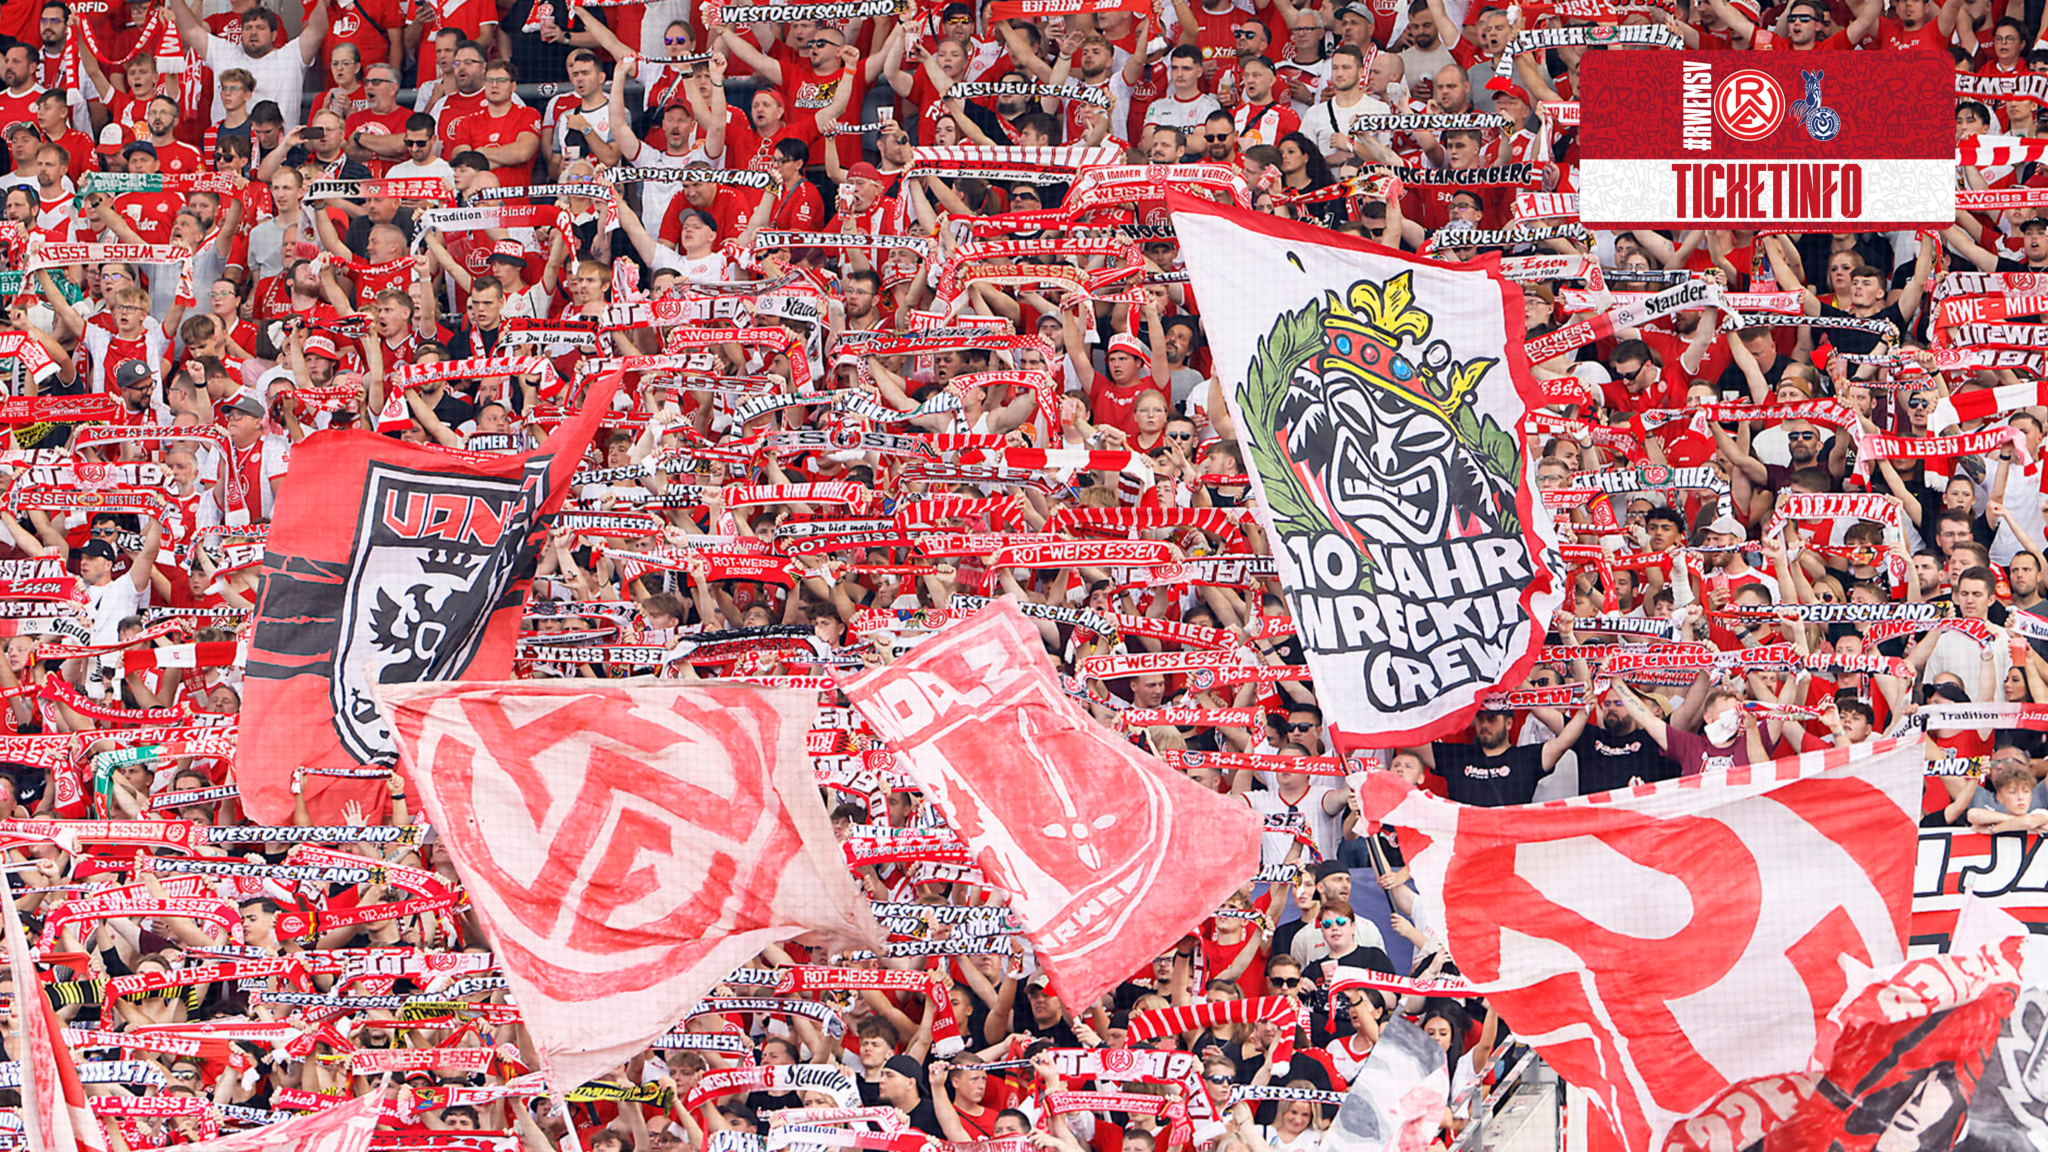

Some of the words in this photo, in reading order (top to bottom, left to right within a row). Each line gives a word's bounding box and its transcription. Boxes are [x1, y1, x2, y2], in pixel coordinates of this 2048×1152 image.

[724, 2, 893, 25] WESTDEUTSCHLAND
[1174, 168, 1202, 180] MEIN
[431, 211, 482, 224] Tradition
[1520, 255, 1569, 270] Essen
[1645, 284, 1707, 315] Stauder
[1947, 305, 1985, 327] RWE
[738, 328, 786, 343] Essen
[1525, 322, 1591, 353] ROT-WEISS
[1528, 332, 1596, 363] ESSEN
[1873, 442, 1901, 457] EIN
[1907, 438, 1960, 457] LEBEN
[20, 493, 78, 505] ESSEN
[1012, 545, 1103, 566] ROT-WEISS
[1104, 542, 1161, 560] ESSEN
[713, 556, 779, 570] ROT-WEISS
[726, 567, 764, 577] ESSEN
[9, 579, 62, 595] Essen
[1086, 653, 1180, 676] ROT-WEISS
[1511, 689, 1572, 705] CREW
[1208, 705, 1250, 724] Essen
[1941, 711, 2000, 723] Tradition
[208, 826, 402, 843] WESTDEUTSCHLAND
[155, 859, 369, 886] WESTDEUTSCHLAND
[70, 900, 158, 915] ROT-WEISS
[165, 899, 223, 914] ESSEN
[235, 958, 299, 979] ESSEN
[803, 969, 879, 983] ROT-WEISS
[884, 970, 928, 985] ESSEN
[1366, 967, 1404, 987] 1907
[353, 1050, 435, 1069] ROT-WEISS
[440, 1050, 492, 1067] ESSEN
[785, 1064, 852, 1093] Stauder
[805, 1109, 857, 1122] WEISS
[782, 1123, 836, 1136] Tradition
